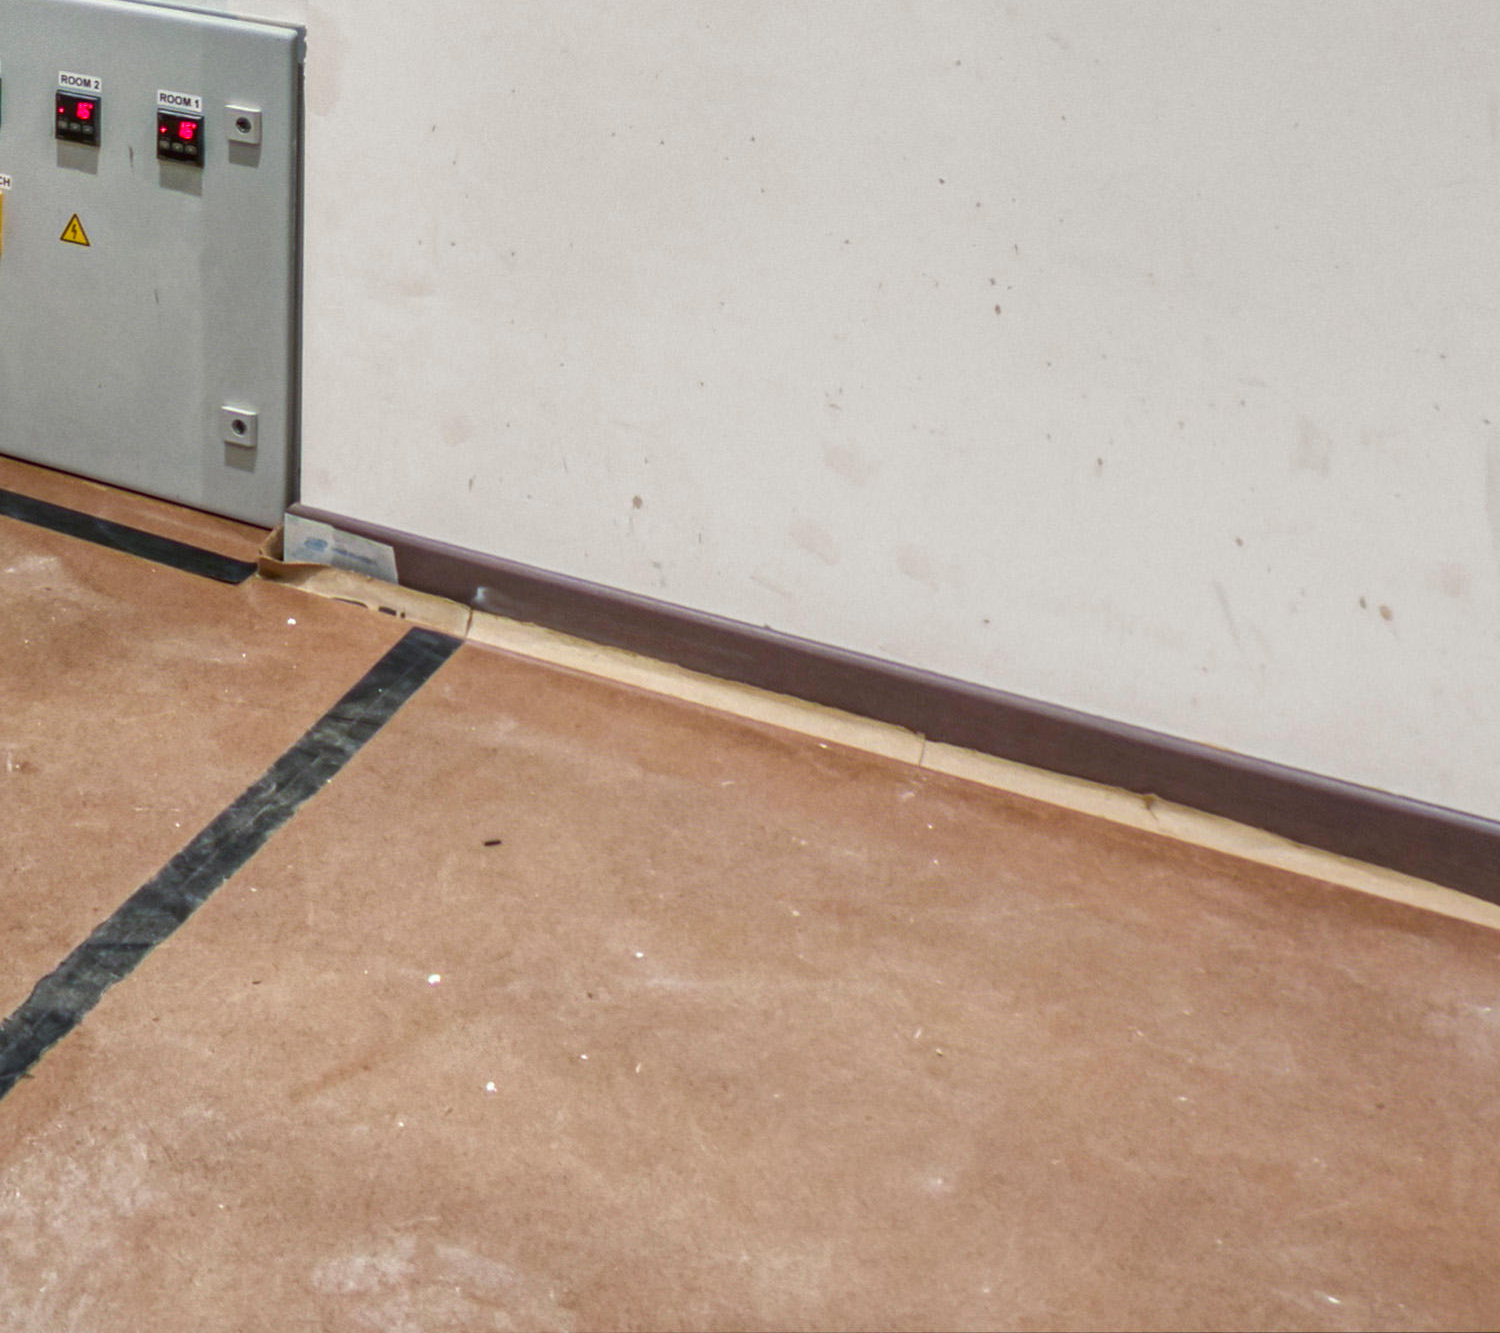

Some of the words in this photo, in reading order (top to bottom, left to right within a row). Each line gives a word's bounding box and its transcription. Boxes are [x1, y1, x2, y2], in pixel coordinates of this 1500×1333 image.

[60, 74, 93, 88] ROOM
[93, 80, 100, 90] 2
[159, 92, 192, 107] ROOM
[194, 99, 200, 109] 1
